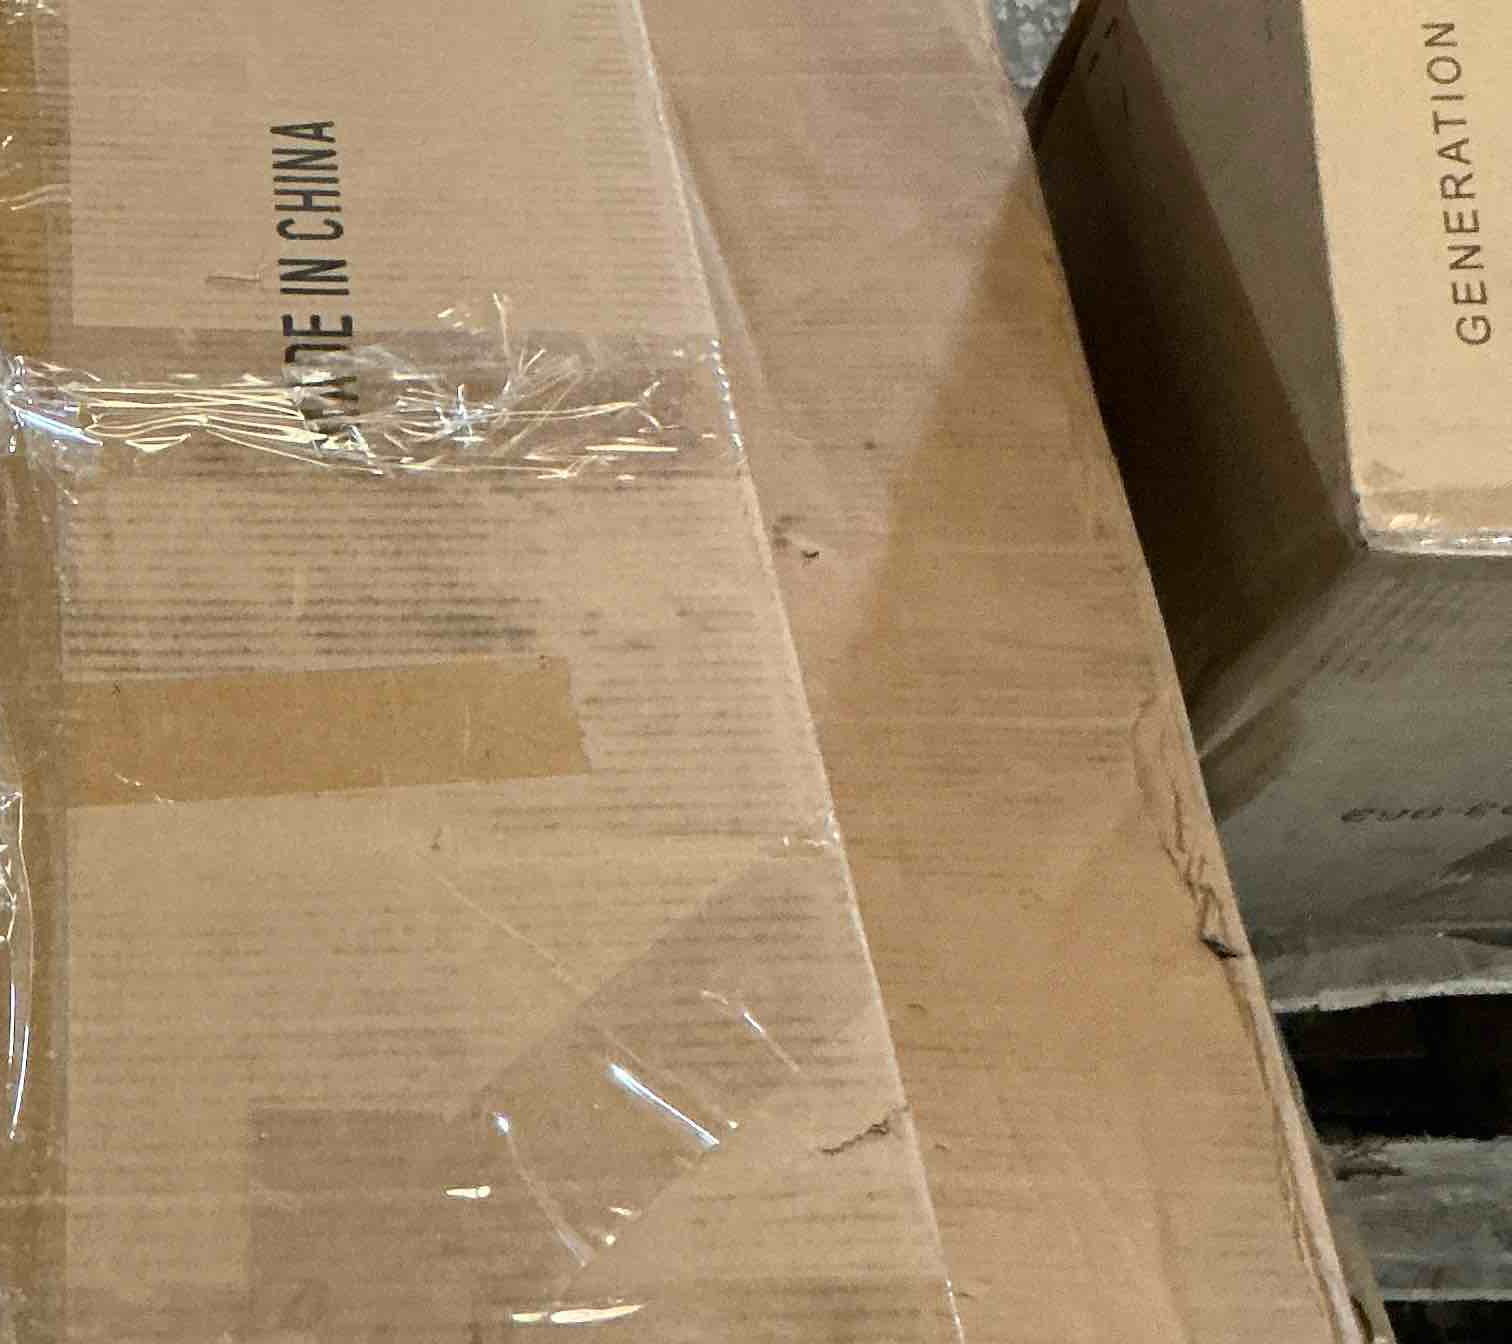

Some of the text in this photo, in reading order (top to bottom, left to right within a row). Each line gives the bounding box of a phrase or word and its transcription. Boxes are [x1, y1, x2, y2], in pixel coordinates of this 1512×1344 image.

[269, 120, 345, 240] CHINA
[1425, 18, 1493, 347] GENERATION
[276, 257, 351, 296] IN
